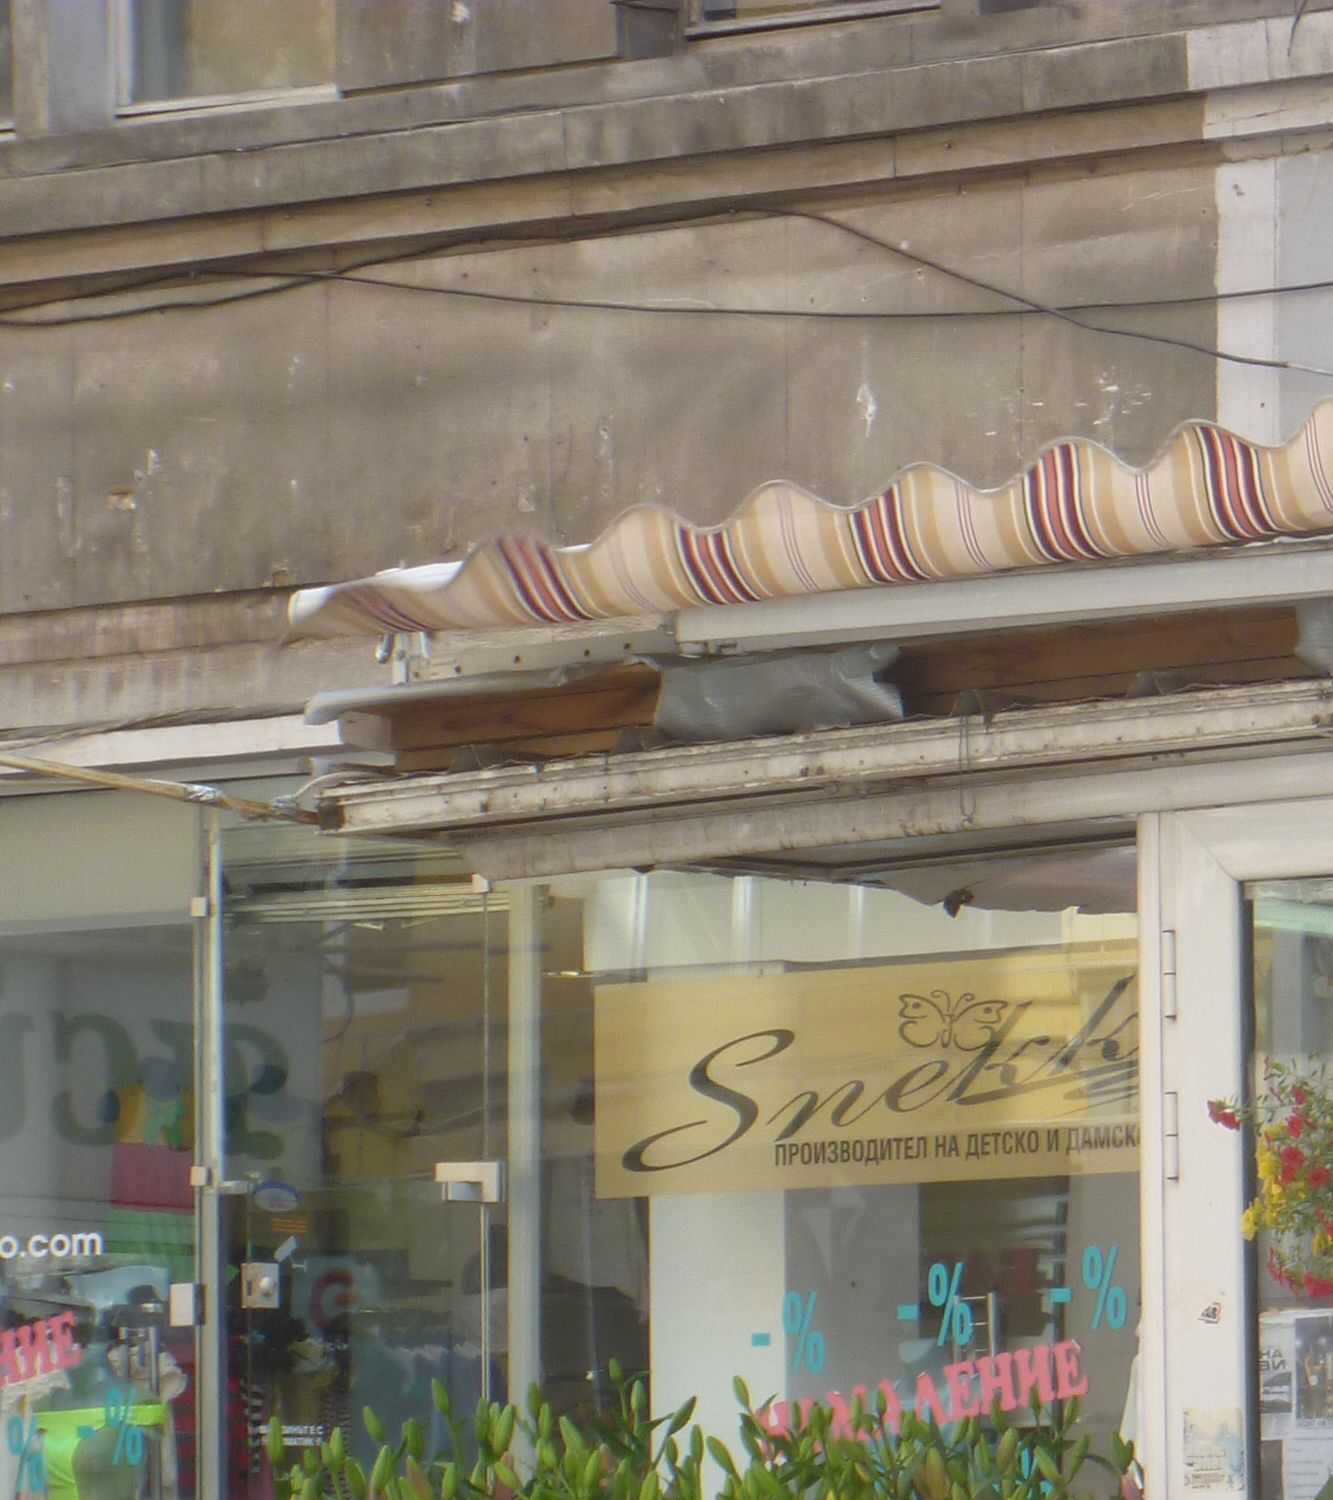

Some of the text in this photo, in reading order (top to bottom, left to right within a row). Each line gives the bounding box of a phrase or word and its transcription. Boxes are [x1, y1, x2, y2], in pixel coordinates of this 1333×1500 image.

[773, 1124, 1141, 1168] ПРОИЗВОДИТЕЛ НА ДЕТСКО И ДАМСК
